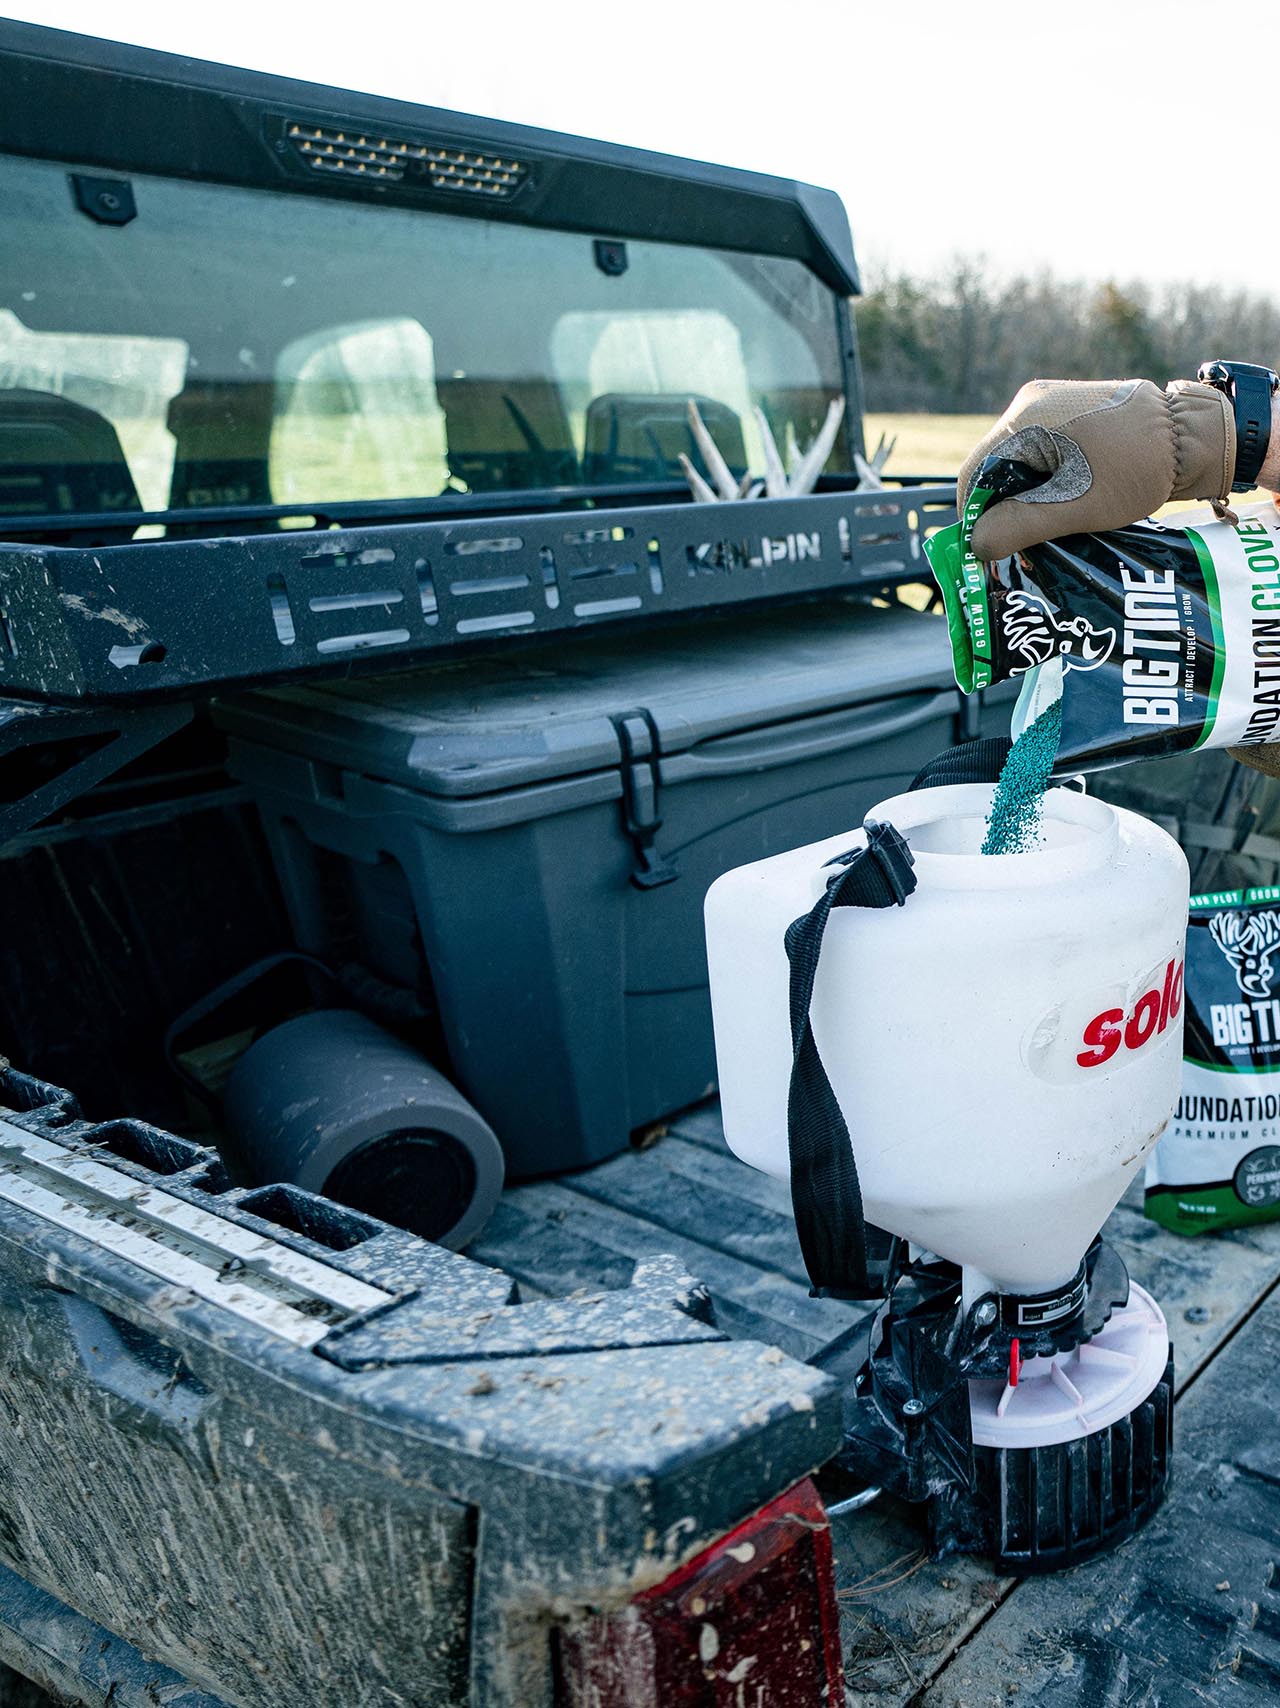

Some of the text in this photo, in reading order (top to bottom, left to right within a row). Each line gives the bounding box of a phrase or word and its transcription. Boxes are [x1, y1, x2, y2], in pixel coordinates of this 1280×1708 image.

[965, 552, 982, 594] YOUR
[971, 603, 986, 648] GROW
[1182, 594, 1196, 703] ATTRACT DEVELOP GROW
[976, 671, 988, 689] OT
[1189, 897, 1210, 907] OUR
[1213, 892, 1239, 905] PLOT
[1250, 888, 1280, 901] GROW
[1175, 1127, 1249, 1140] PREMIUM
